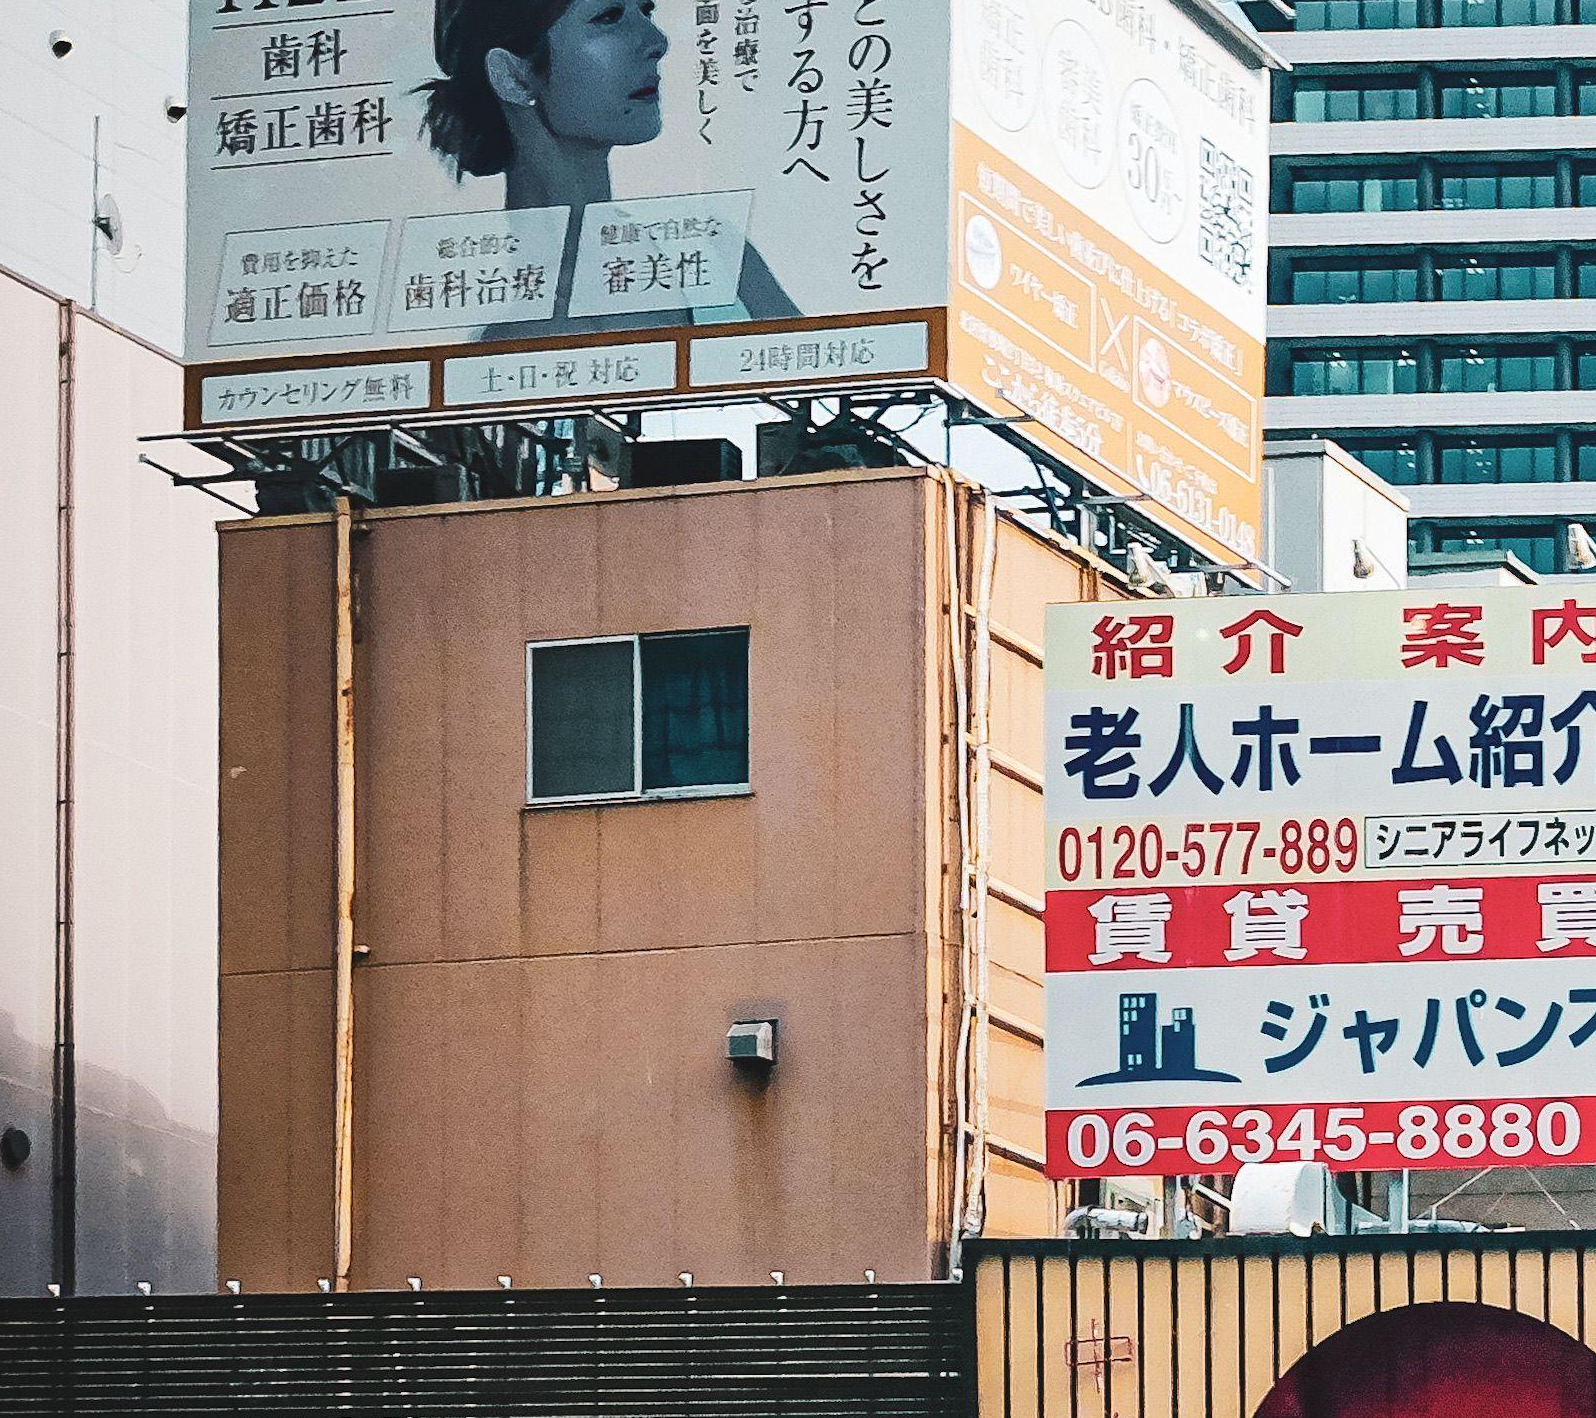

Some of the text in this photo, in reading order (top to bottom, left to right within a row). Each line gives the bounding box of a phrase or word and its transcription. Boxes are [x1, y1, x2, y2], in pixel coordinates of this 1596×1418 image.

[261, 28, 348, 81] 歯科
[214, 96, 394, 157] 矯正歯科
[405, 264, 546, 312] 歯科治療
[603, 249, 711, 297] 審美性
[224, 278, 366, 324] 適正価格
[588, 355, 641, 386] 対応
[738, 337, 876, 374] 24時間対応
[217, 372, 414, 412] カウンセリング無料
[1089, 605, 1306, 682] 紹介
[1057, 817, 1359, 883] 0120-577-889
[1087, 891, 1311, 966] 賃貸
[1065, 1099, 1583, 1171] 06-6345-8880
